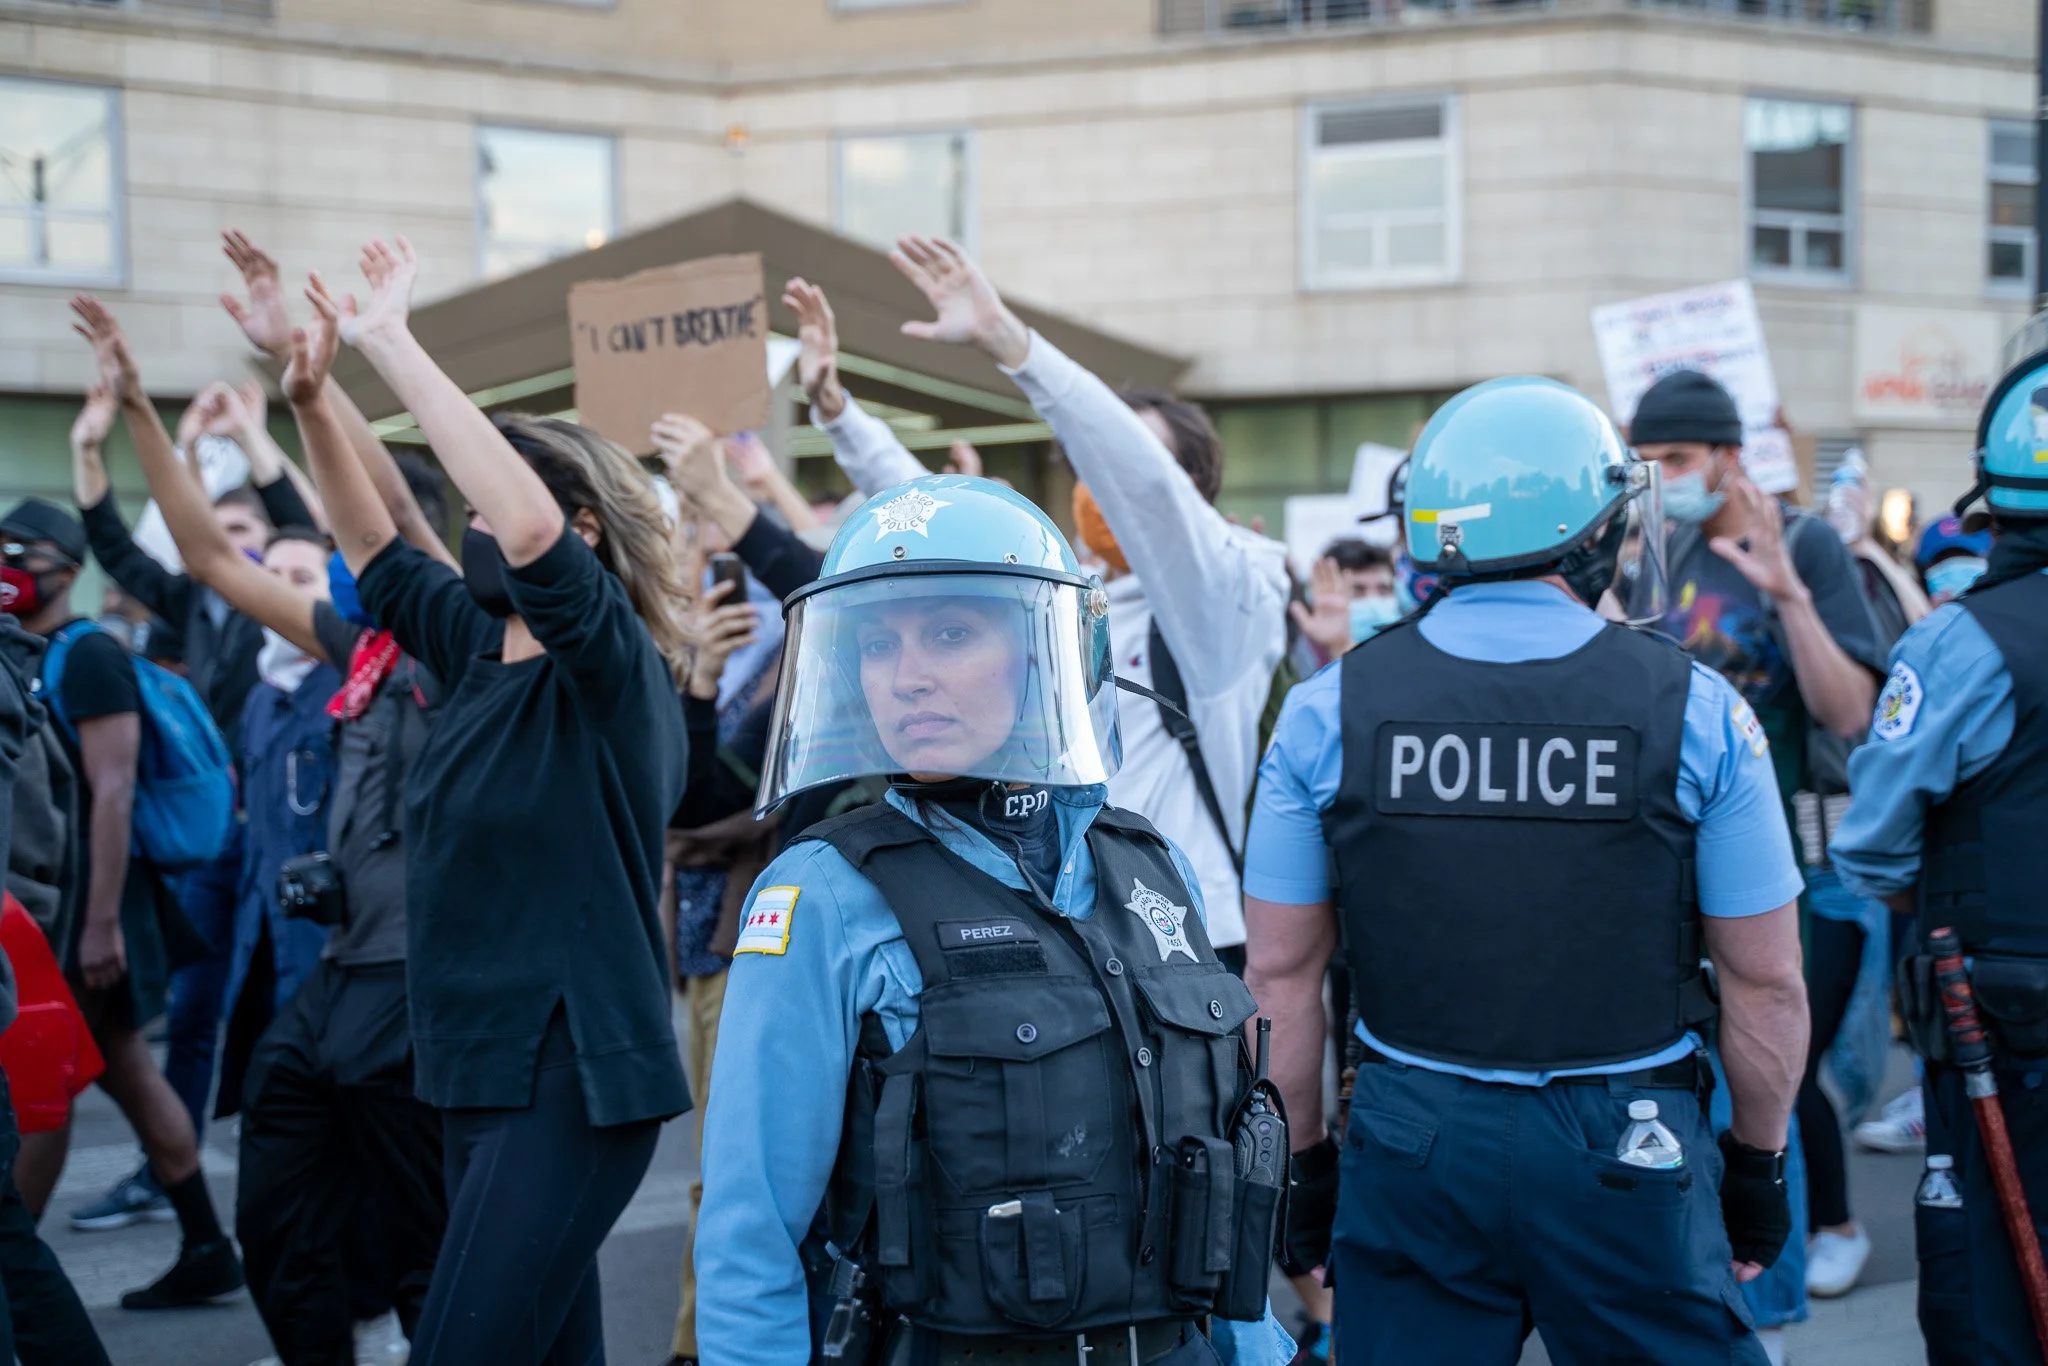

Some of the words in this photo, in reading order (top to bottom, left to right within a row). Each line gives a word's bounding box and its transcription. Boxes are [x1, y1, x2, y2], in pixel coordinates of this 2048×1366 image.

[882, 493, 934, 510] CHICAGO
[881, 515, 926, 531] POLICE
[1391, 733, 1618, 806] POLICE
[1005, 789, 1048, 817] CPD
[960, 925, 1014, 941] PEREZ
